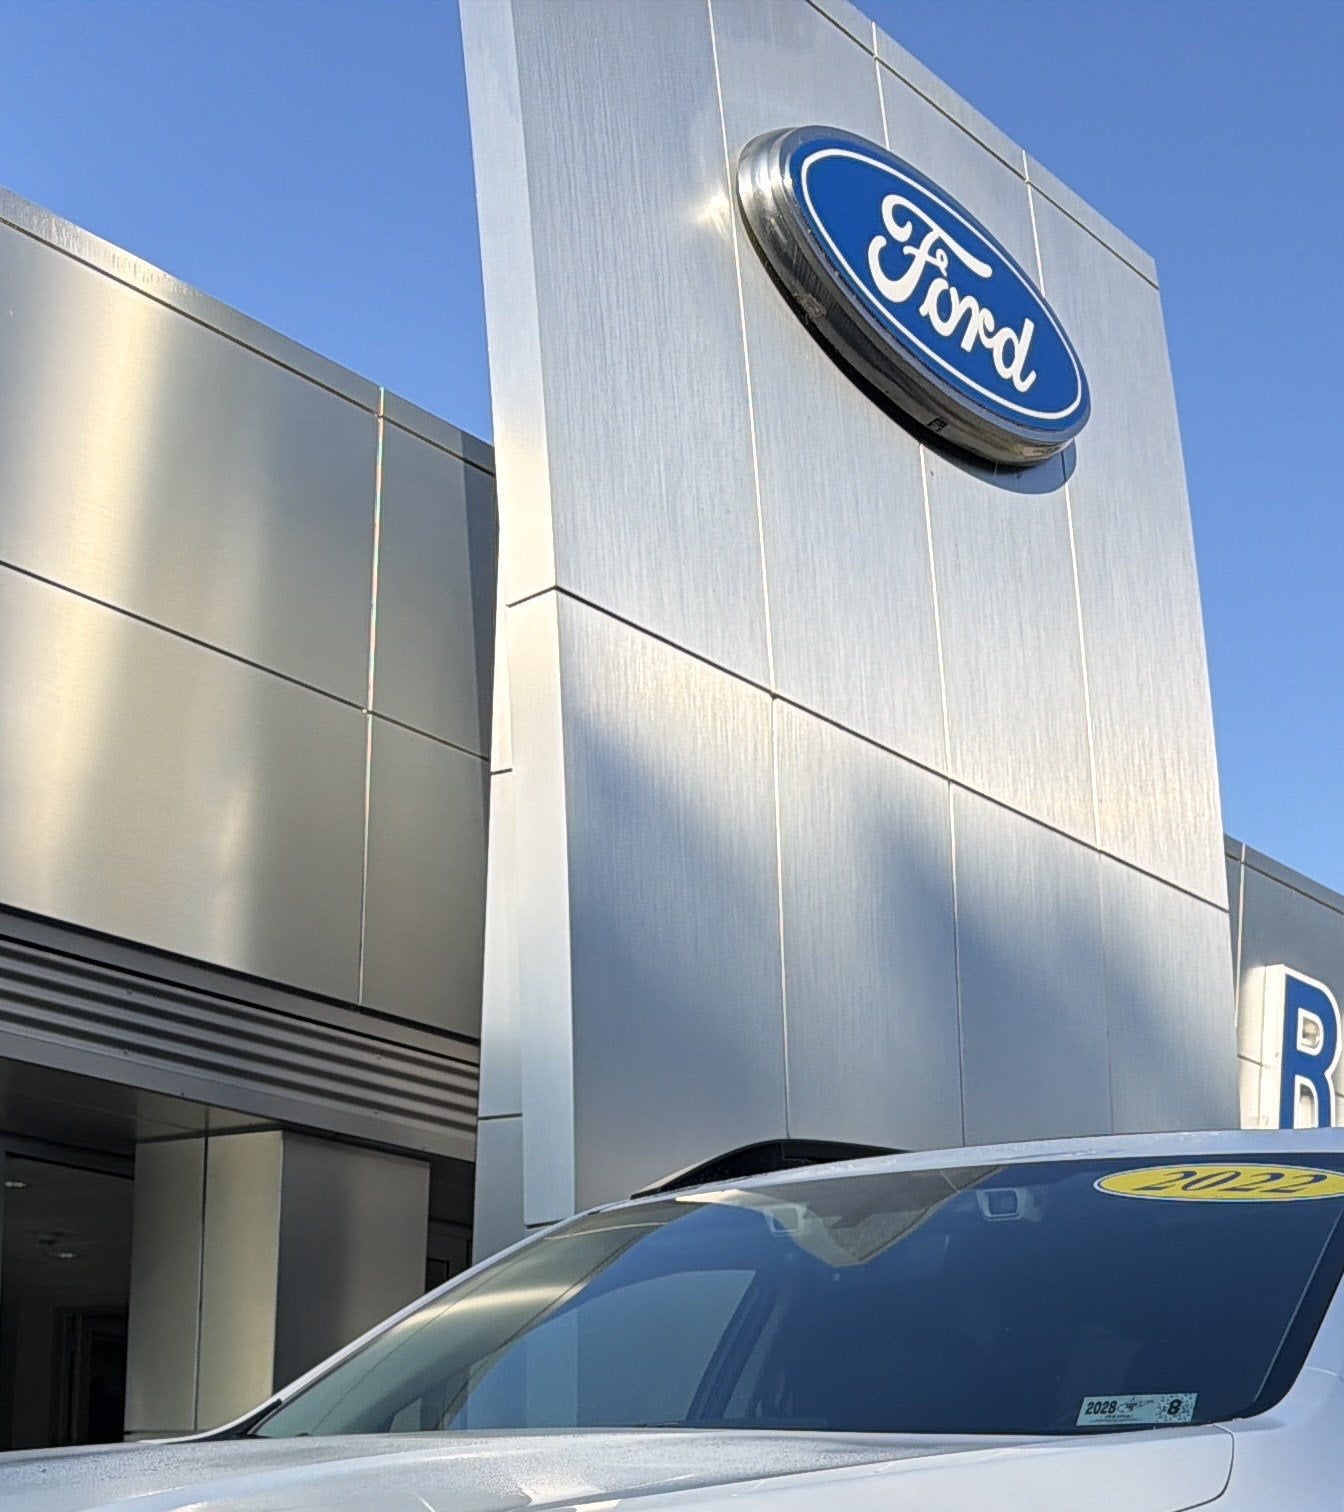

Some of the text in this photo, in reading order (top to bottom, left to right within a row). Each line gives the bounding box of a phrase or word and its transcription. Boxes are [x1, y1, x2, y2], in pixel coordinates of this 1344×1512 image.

[868, 194, 1037, 392] Ford
[1131, 1170, 1328, 1194] 2022
[1085, 1400, 1118, 1415] 2028
